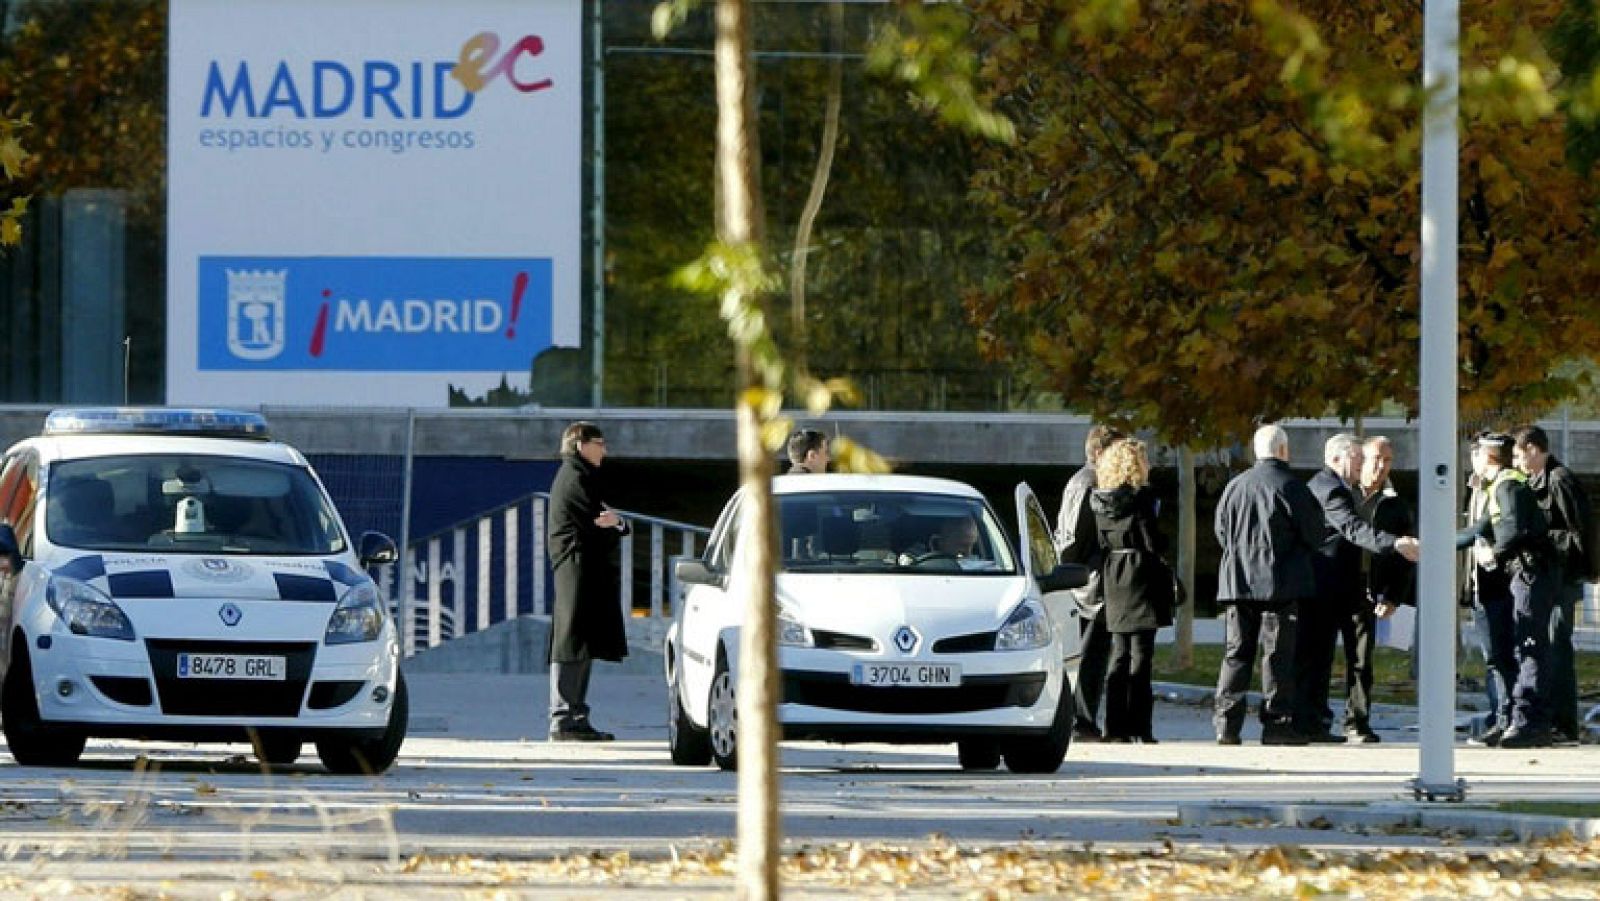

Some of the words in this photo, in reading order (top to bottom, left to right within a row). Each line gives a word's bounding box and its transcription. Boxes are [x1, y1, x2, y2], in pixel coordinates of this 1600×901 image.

[200, 60, 476, 119] MADRID
[450, 30, 554, 93] ec
[200, 125, 313, 152] espacios
[320, 129, 335, 153] y
[343, 129, 475, 154] congresos
[192, 656, 237, 676] 8478
[246, 659, 278, 677] GRL
[869, 666, 911, 683] 3704
[918, 666, 951, 683] GHN
